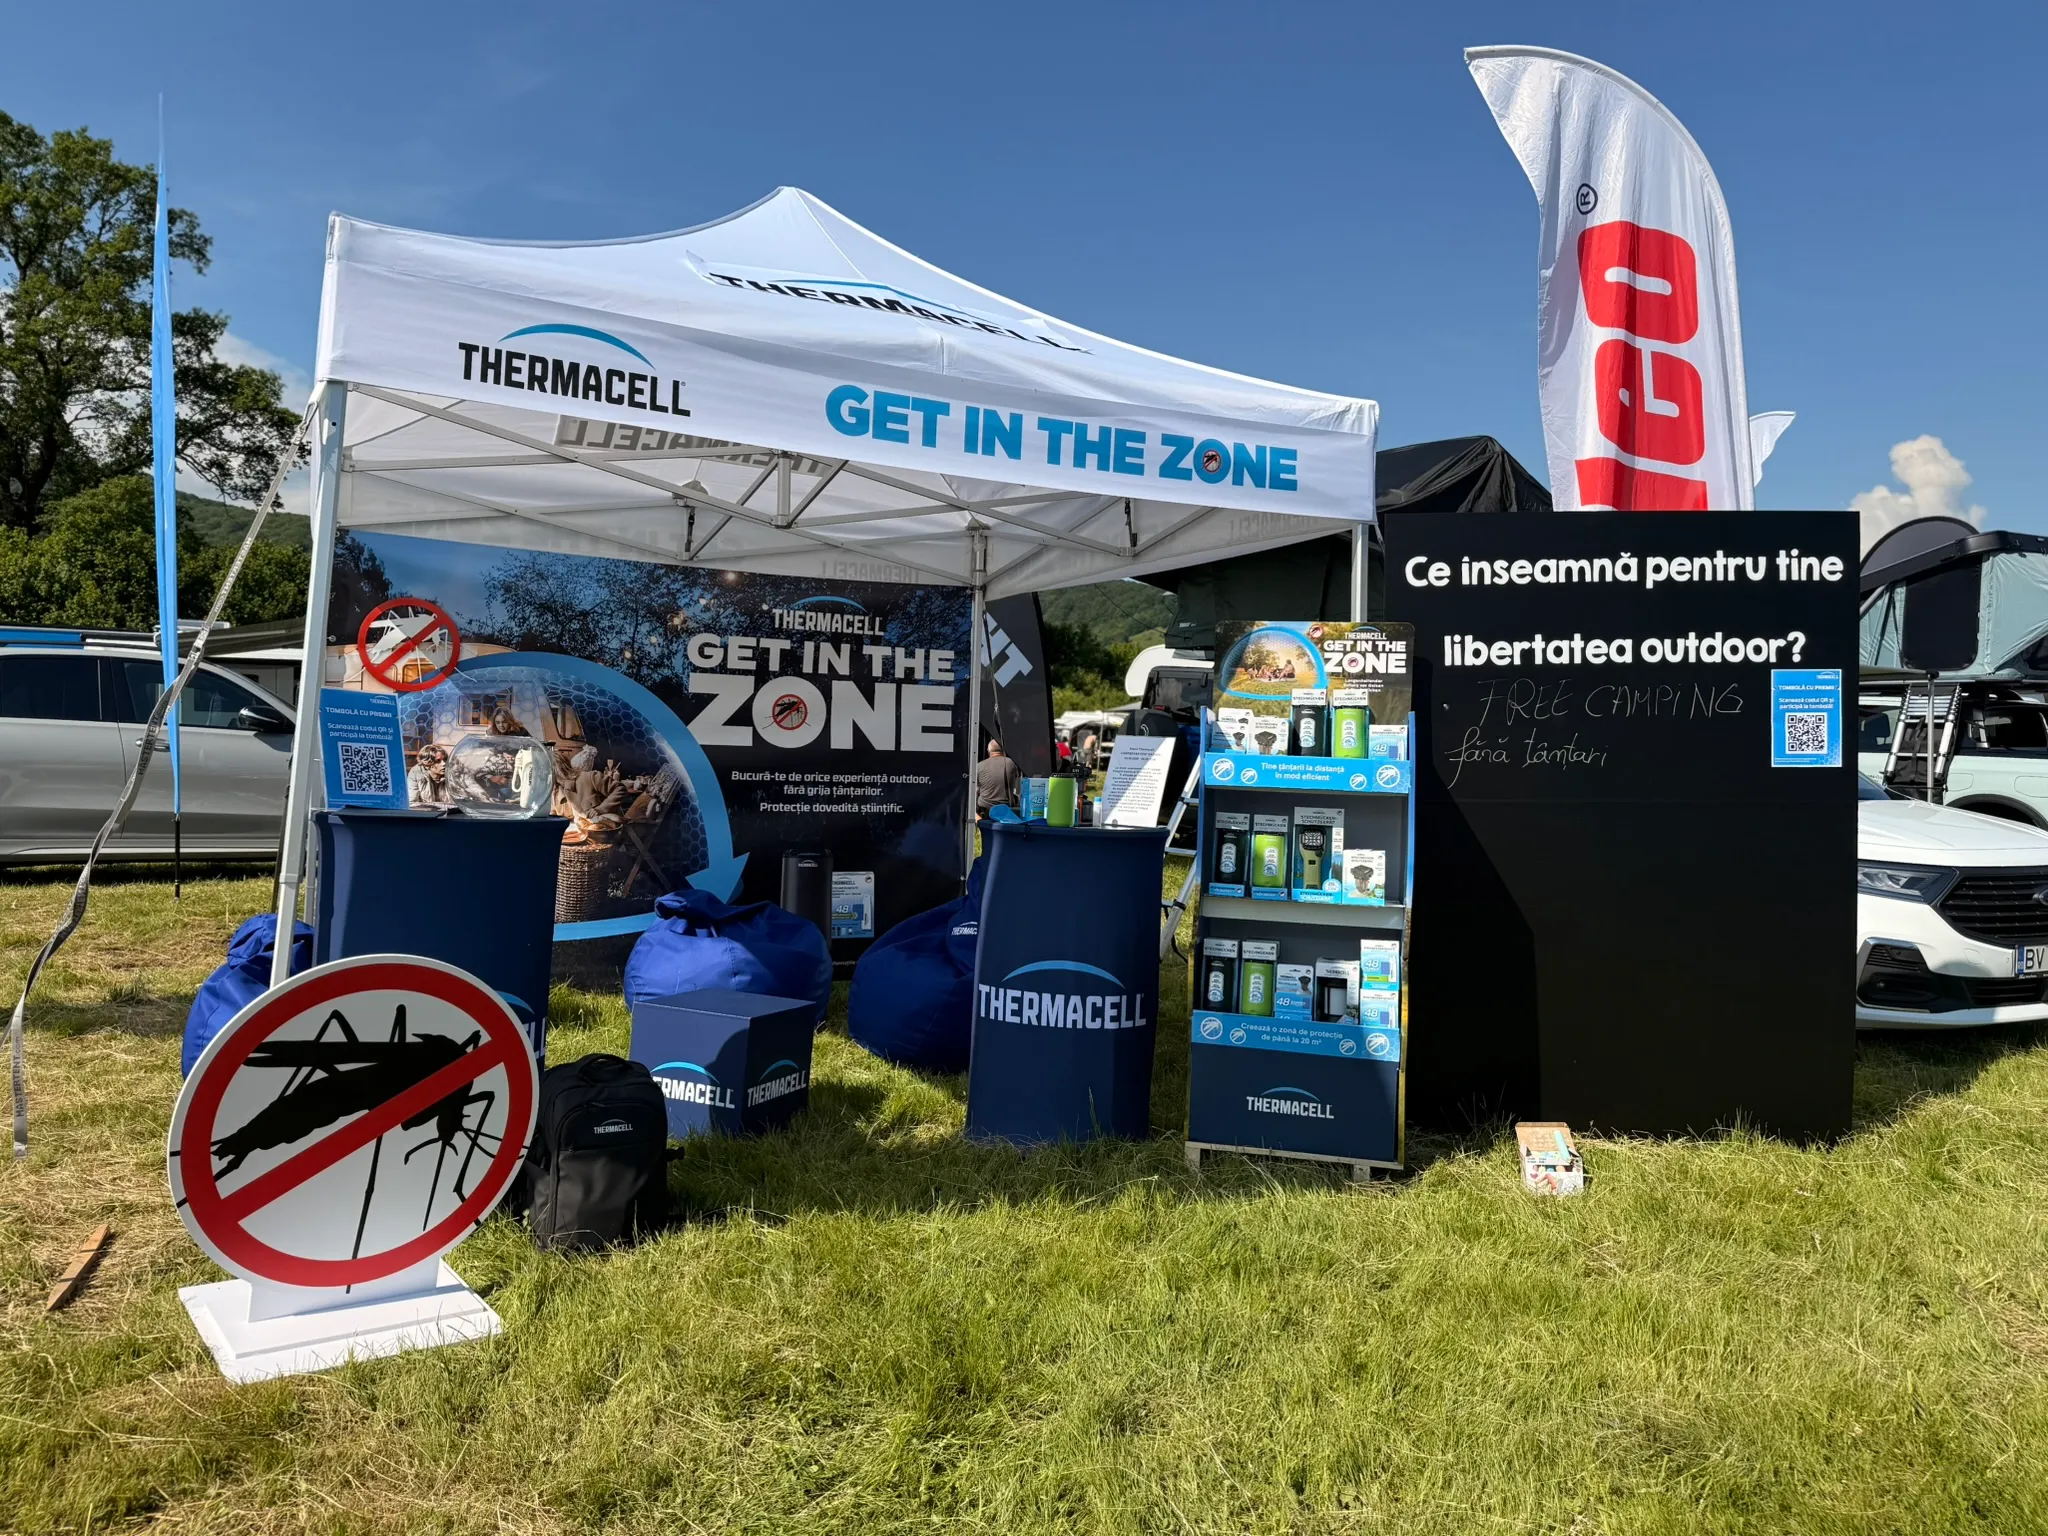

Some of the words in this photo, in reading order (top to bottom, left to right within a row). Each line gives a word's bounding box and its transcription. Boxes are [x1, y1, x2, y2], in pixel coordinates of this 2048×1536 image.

[709, 272, 1093, 354] THERMACELL
[458, 342, 691, 417] THERMACELL
[825, 384, 950, 448] GET
[963, 405, 1023, 460] IN
[1037, 416, 1146, 476] THE
[1158, 432, 1298, 492] ZONE
[1404, 555, 1451, 588] Ce
[1460, 552, 1638, 586] înseamnă
[1645, 550, 1767, 590] pentru
[1776, 549, 1844, 583] tine
[772, 608, 885, 636] THERMACELL
[1344, 632, 1387, 640] THERMACELL
[1323, 640, 1354, 651] GET
[1356, 640, 1373, 652] IN
[1375, 641, 1407, 652] THE
[1443, 633, 1633, 667] libertatea
[1640, 631, 1807, 664] outdoor?
[687, 632, 791, 672] GET
[802, 640, 850, 675] IN
[862, 644, 955, 681] THE
[1324, 652, 1407, 674] ZONE
[1477, 677, 1573, 727] FREE
[325, 706, 359, 716] TOMBOLĂ
[686, 672, 955, 753] ZONE
[327, 722, 359, 731] Scanează
[1373, 743, 1388, 752] 48
[1444, 726, 1511, 789] fără
[731, 770, 786, 782] Bucură-te
[788, 771, 802, 782] de
[804, 772, 830, 783] orice
[832, 773, 888, 785] experiență
[889, 774, 932, 785] outdoor,
[1275, 771, 1282, 779] în
[1302, 773, 1330, 781] eficient
[1314, 765, 1345, 774] distanță
[783, 785, 805, 795] fără
[807, 785, 831, 797] grija
[832, 785, 884, 798] țânțarilor.
[759, 802, 811, 815] Protecție
[812, 802, 858, 813] dovedită
[860, 803, 905, 815] științific.
[836, 904, 849, 914] 48
[1365, 959, 1379, 968] 48
[2025, 947, 2045, 970] BV
[978, 983, 1147, 1030] THERMACELL
[1276, 997, 1291, 1006] 48
[1364, 1008, 1379, 1018] 48
[1241, 1022, 1271, 1032] Creează
[1279, 1026, 1297, 1034] zonă
[1310, 1030, 1343, 1040] protecție
[1272, 1035, 1290, 1044] până
[747, 1070, 807, 1108] THERMACELL
[1246, 1096, 1334, 1119] THERMACELL
[593, 1124, 633, 1135] THERMACELL
